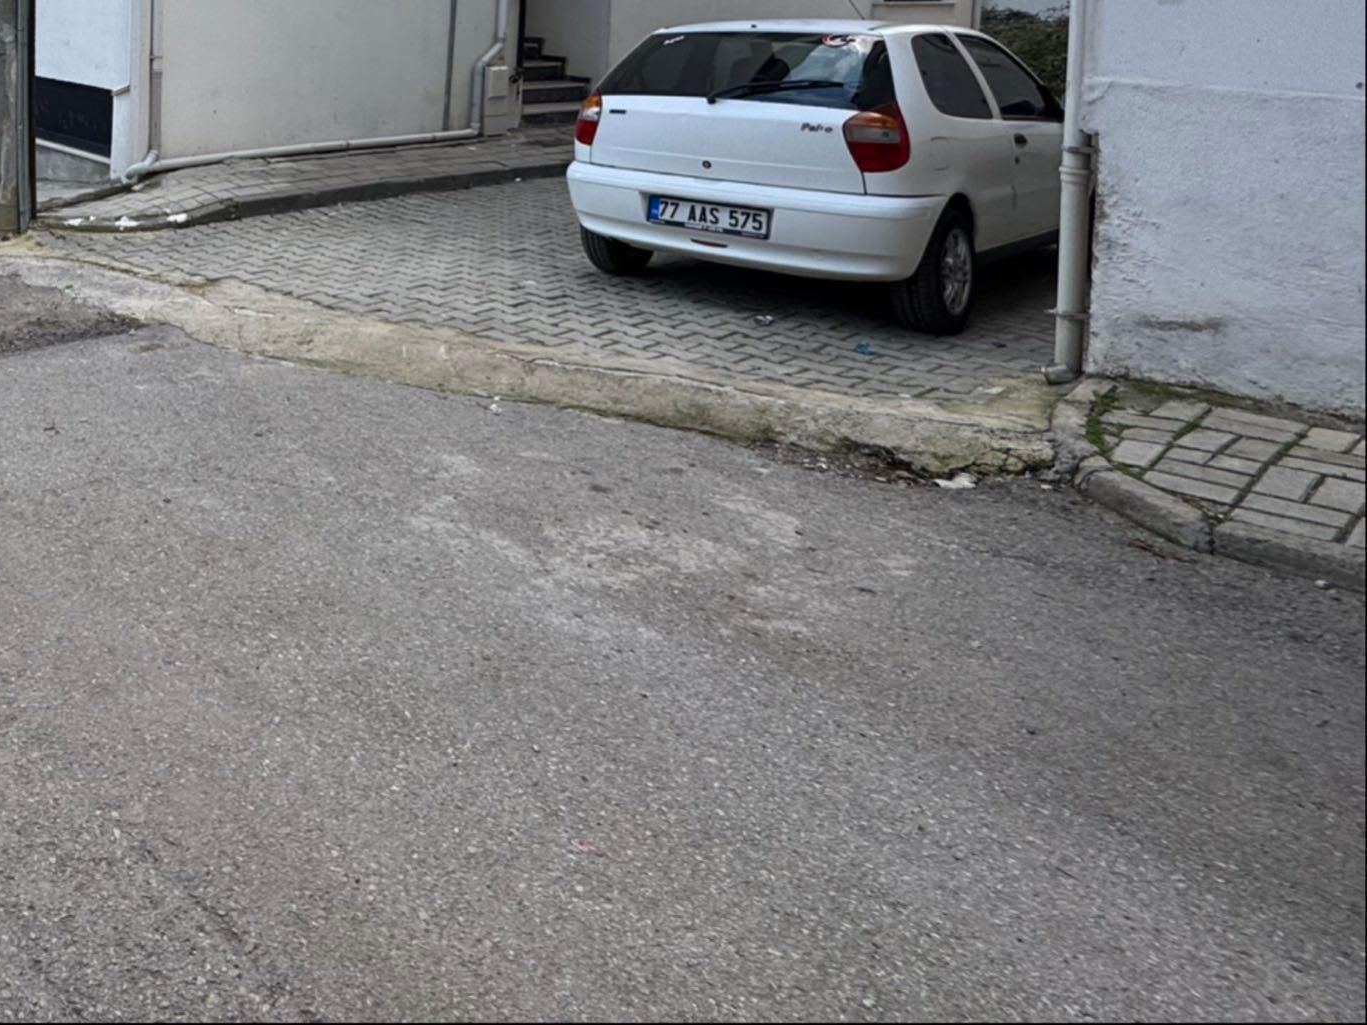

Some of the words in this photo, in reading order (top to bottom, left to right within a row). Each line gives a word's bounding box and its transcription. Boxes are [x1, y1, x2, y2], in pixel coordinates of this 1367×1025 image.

[659, 200, 680, 219] 77
[687, 204, 721, 225] AAS
[728, 209, 764, 232] 575
